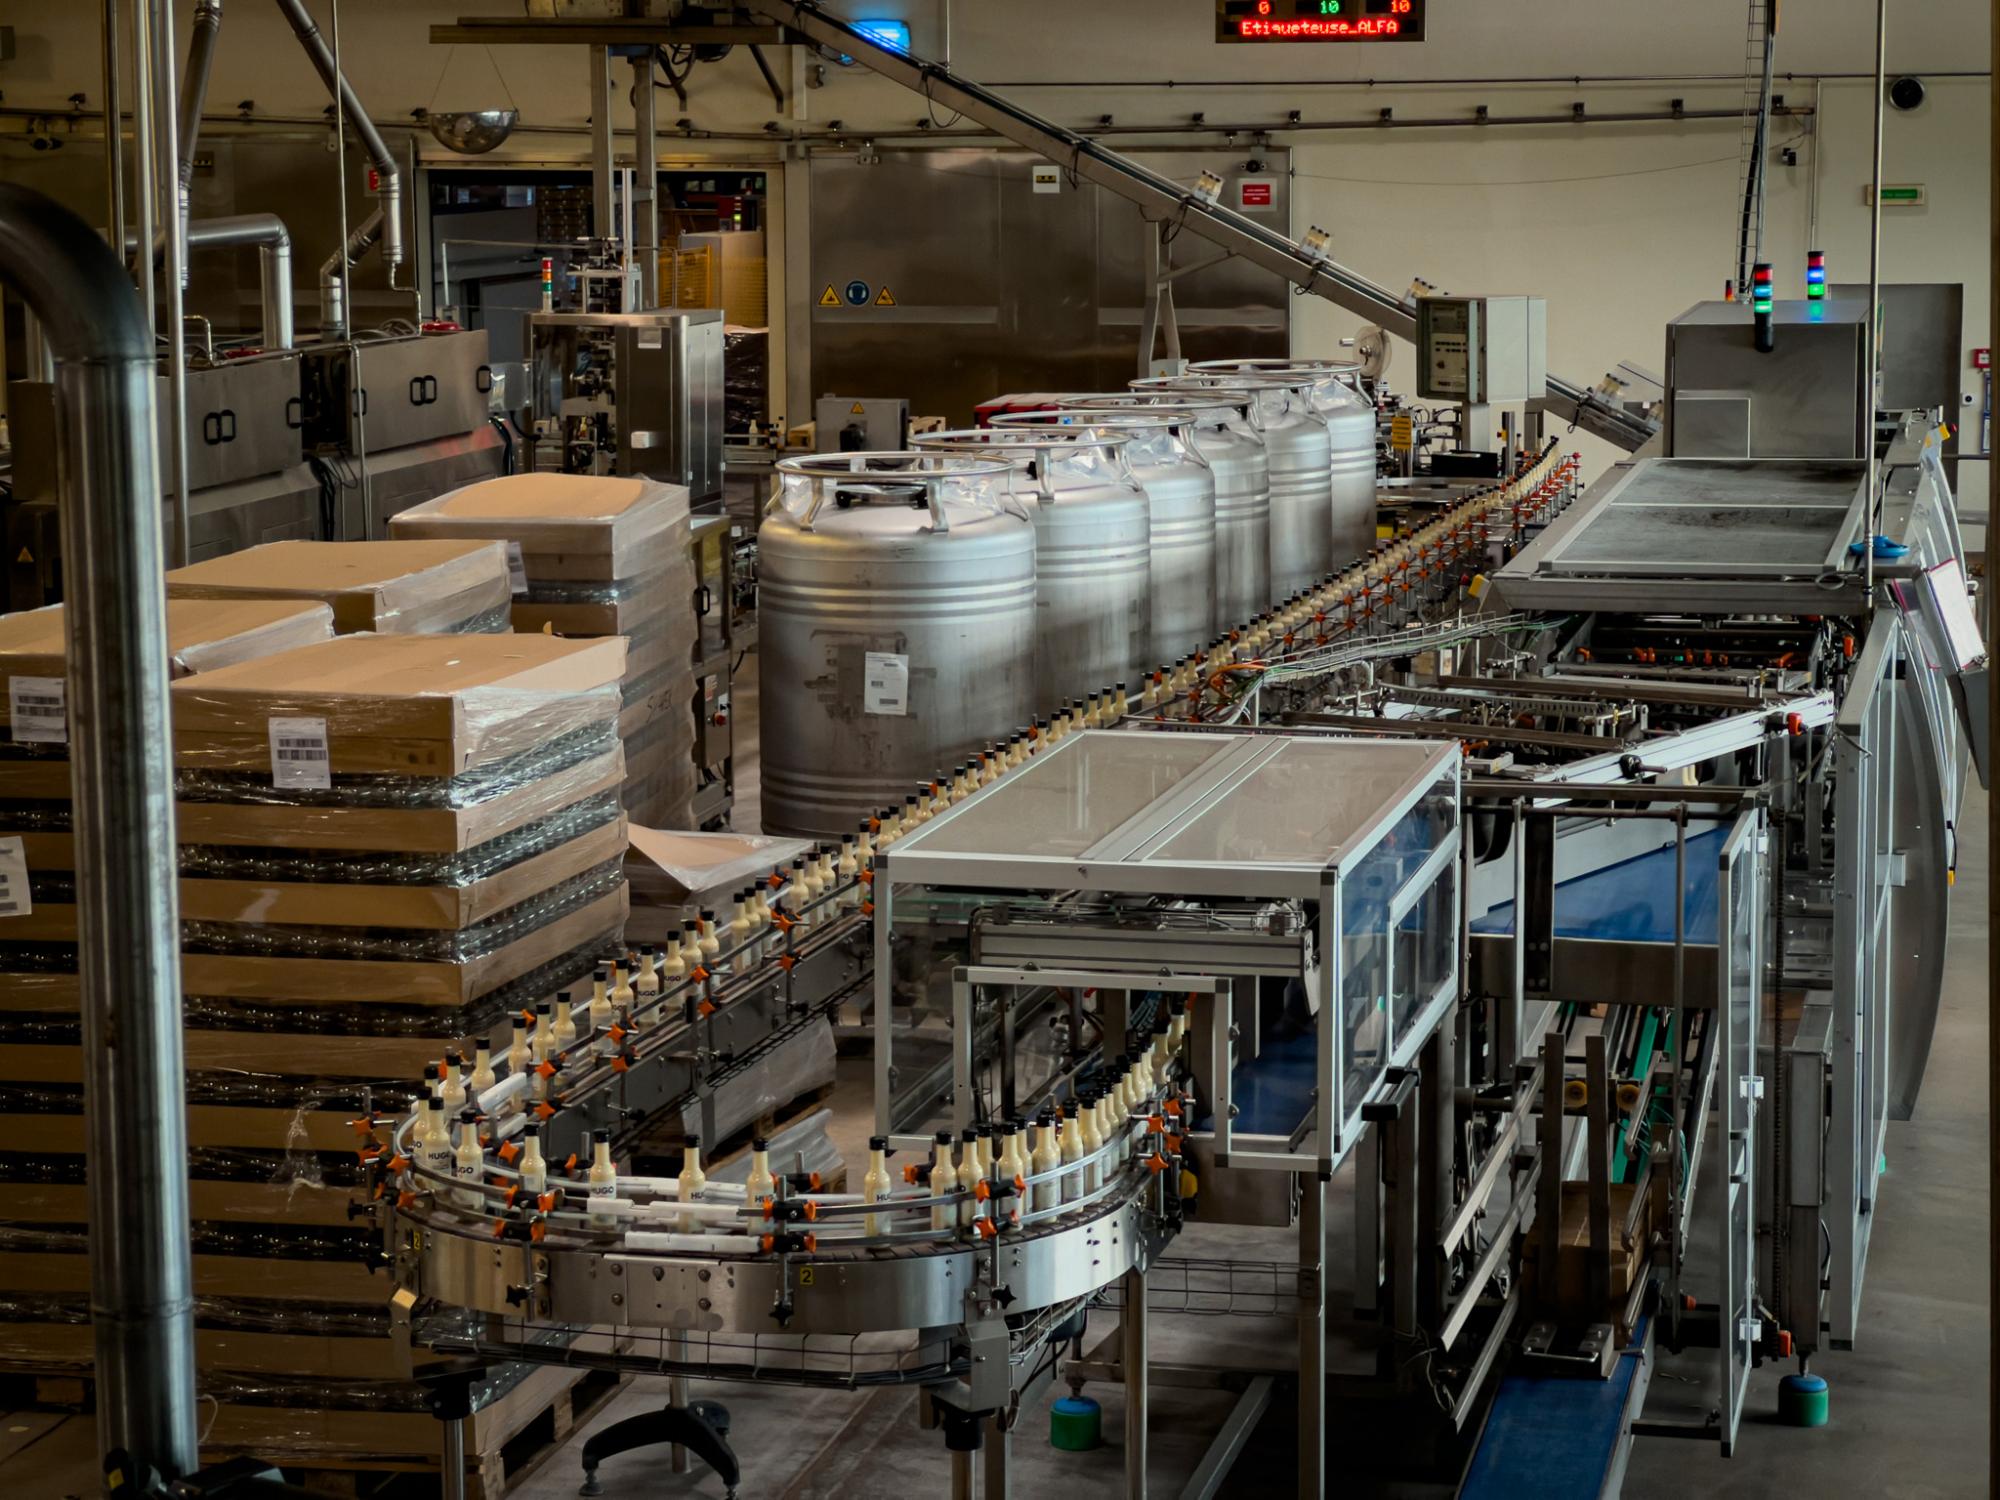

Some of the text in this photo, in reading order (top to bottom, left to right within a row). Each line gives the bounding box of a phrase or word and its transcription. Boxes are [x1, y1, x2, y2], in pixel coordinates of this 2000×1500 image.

[1259, 0, 1410, 14] 0 10 10
[802, 1269, 812, 1283] 2
